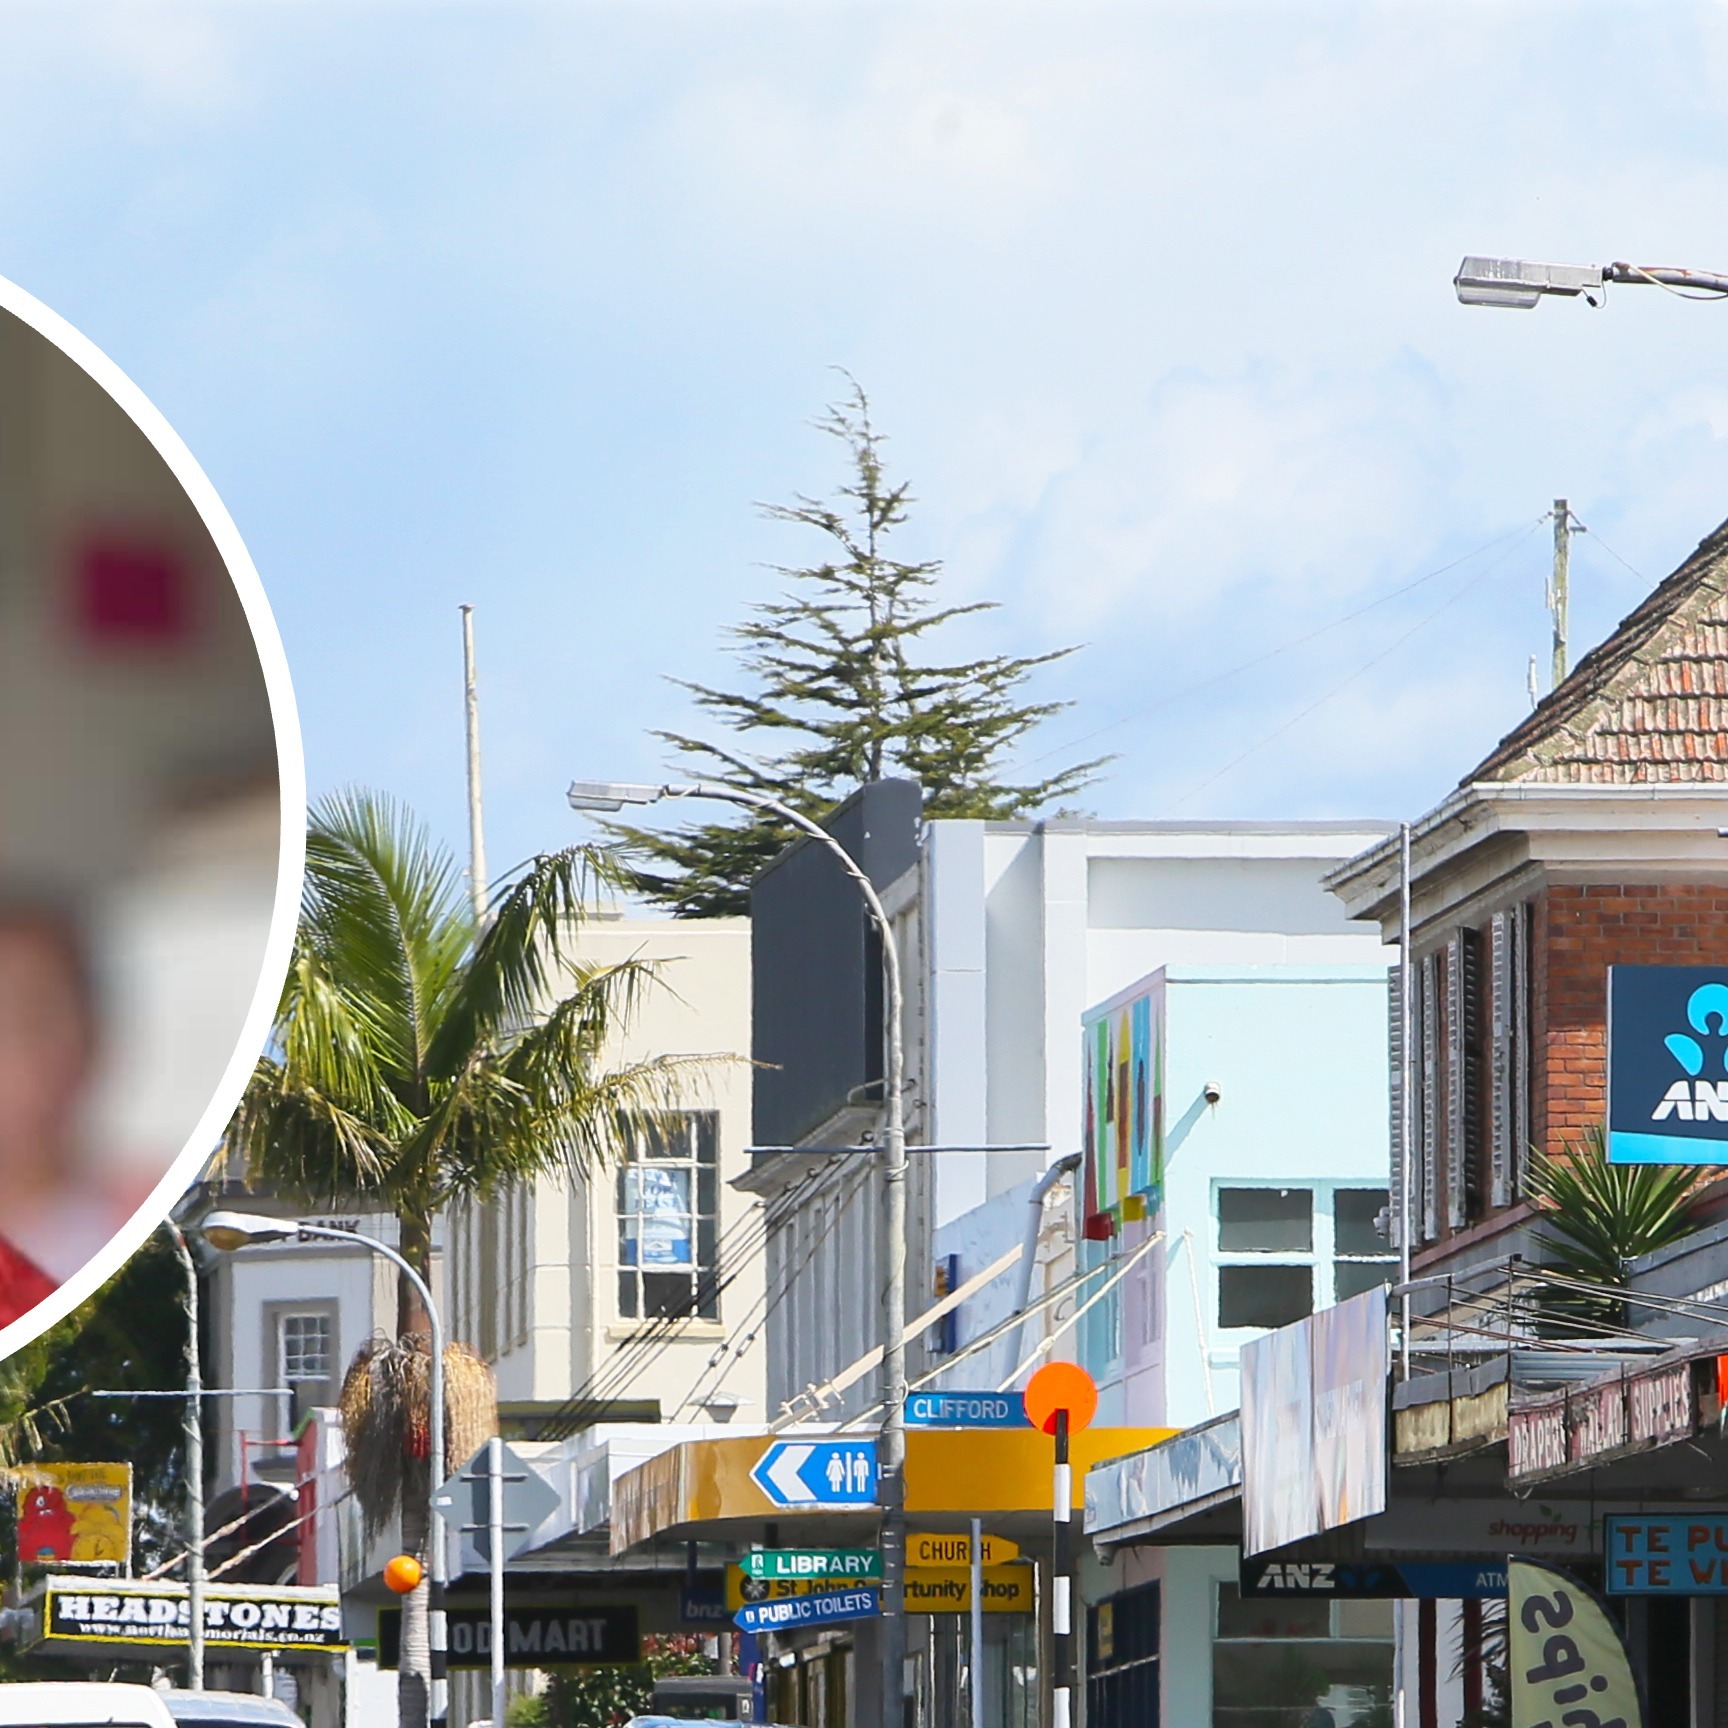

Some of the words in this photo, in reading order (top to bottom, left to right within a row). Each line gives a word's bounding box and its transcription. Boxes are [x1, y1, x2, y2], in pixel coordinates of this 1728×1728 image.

[913, 1398, 1009, 1419] CLIFFORD
[1633, 1368, 1691, 1441] SUPPLIES
[1488, 1518, 1578, 1546] shopping
[1615, 1525, 1670, 1553] TE
[919, 1541, 991, 1561] CHURH
[776, 1555, 874, 1575] LIBRARY
[1256, 1563, 1336, 1589] ANZ
[1615, 1559, 1670, 1586] TE
[777, 1578, 798, 1597] St
[981, 1579, 1020, 1600] hop
[1476, 1572, 1510, 1588] ATM
[685, 1603, 722, 1620] bnz
[758, 1602, 812, 1625] PUBLIC
[813, 1592, 873, 1616] TOILETS
[507, 1618, 608, 1653] MART
